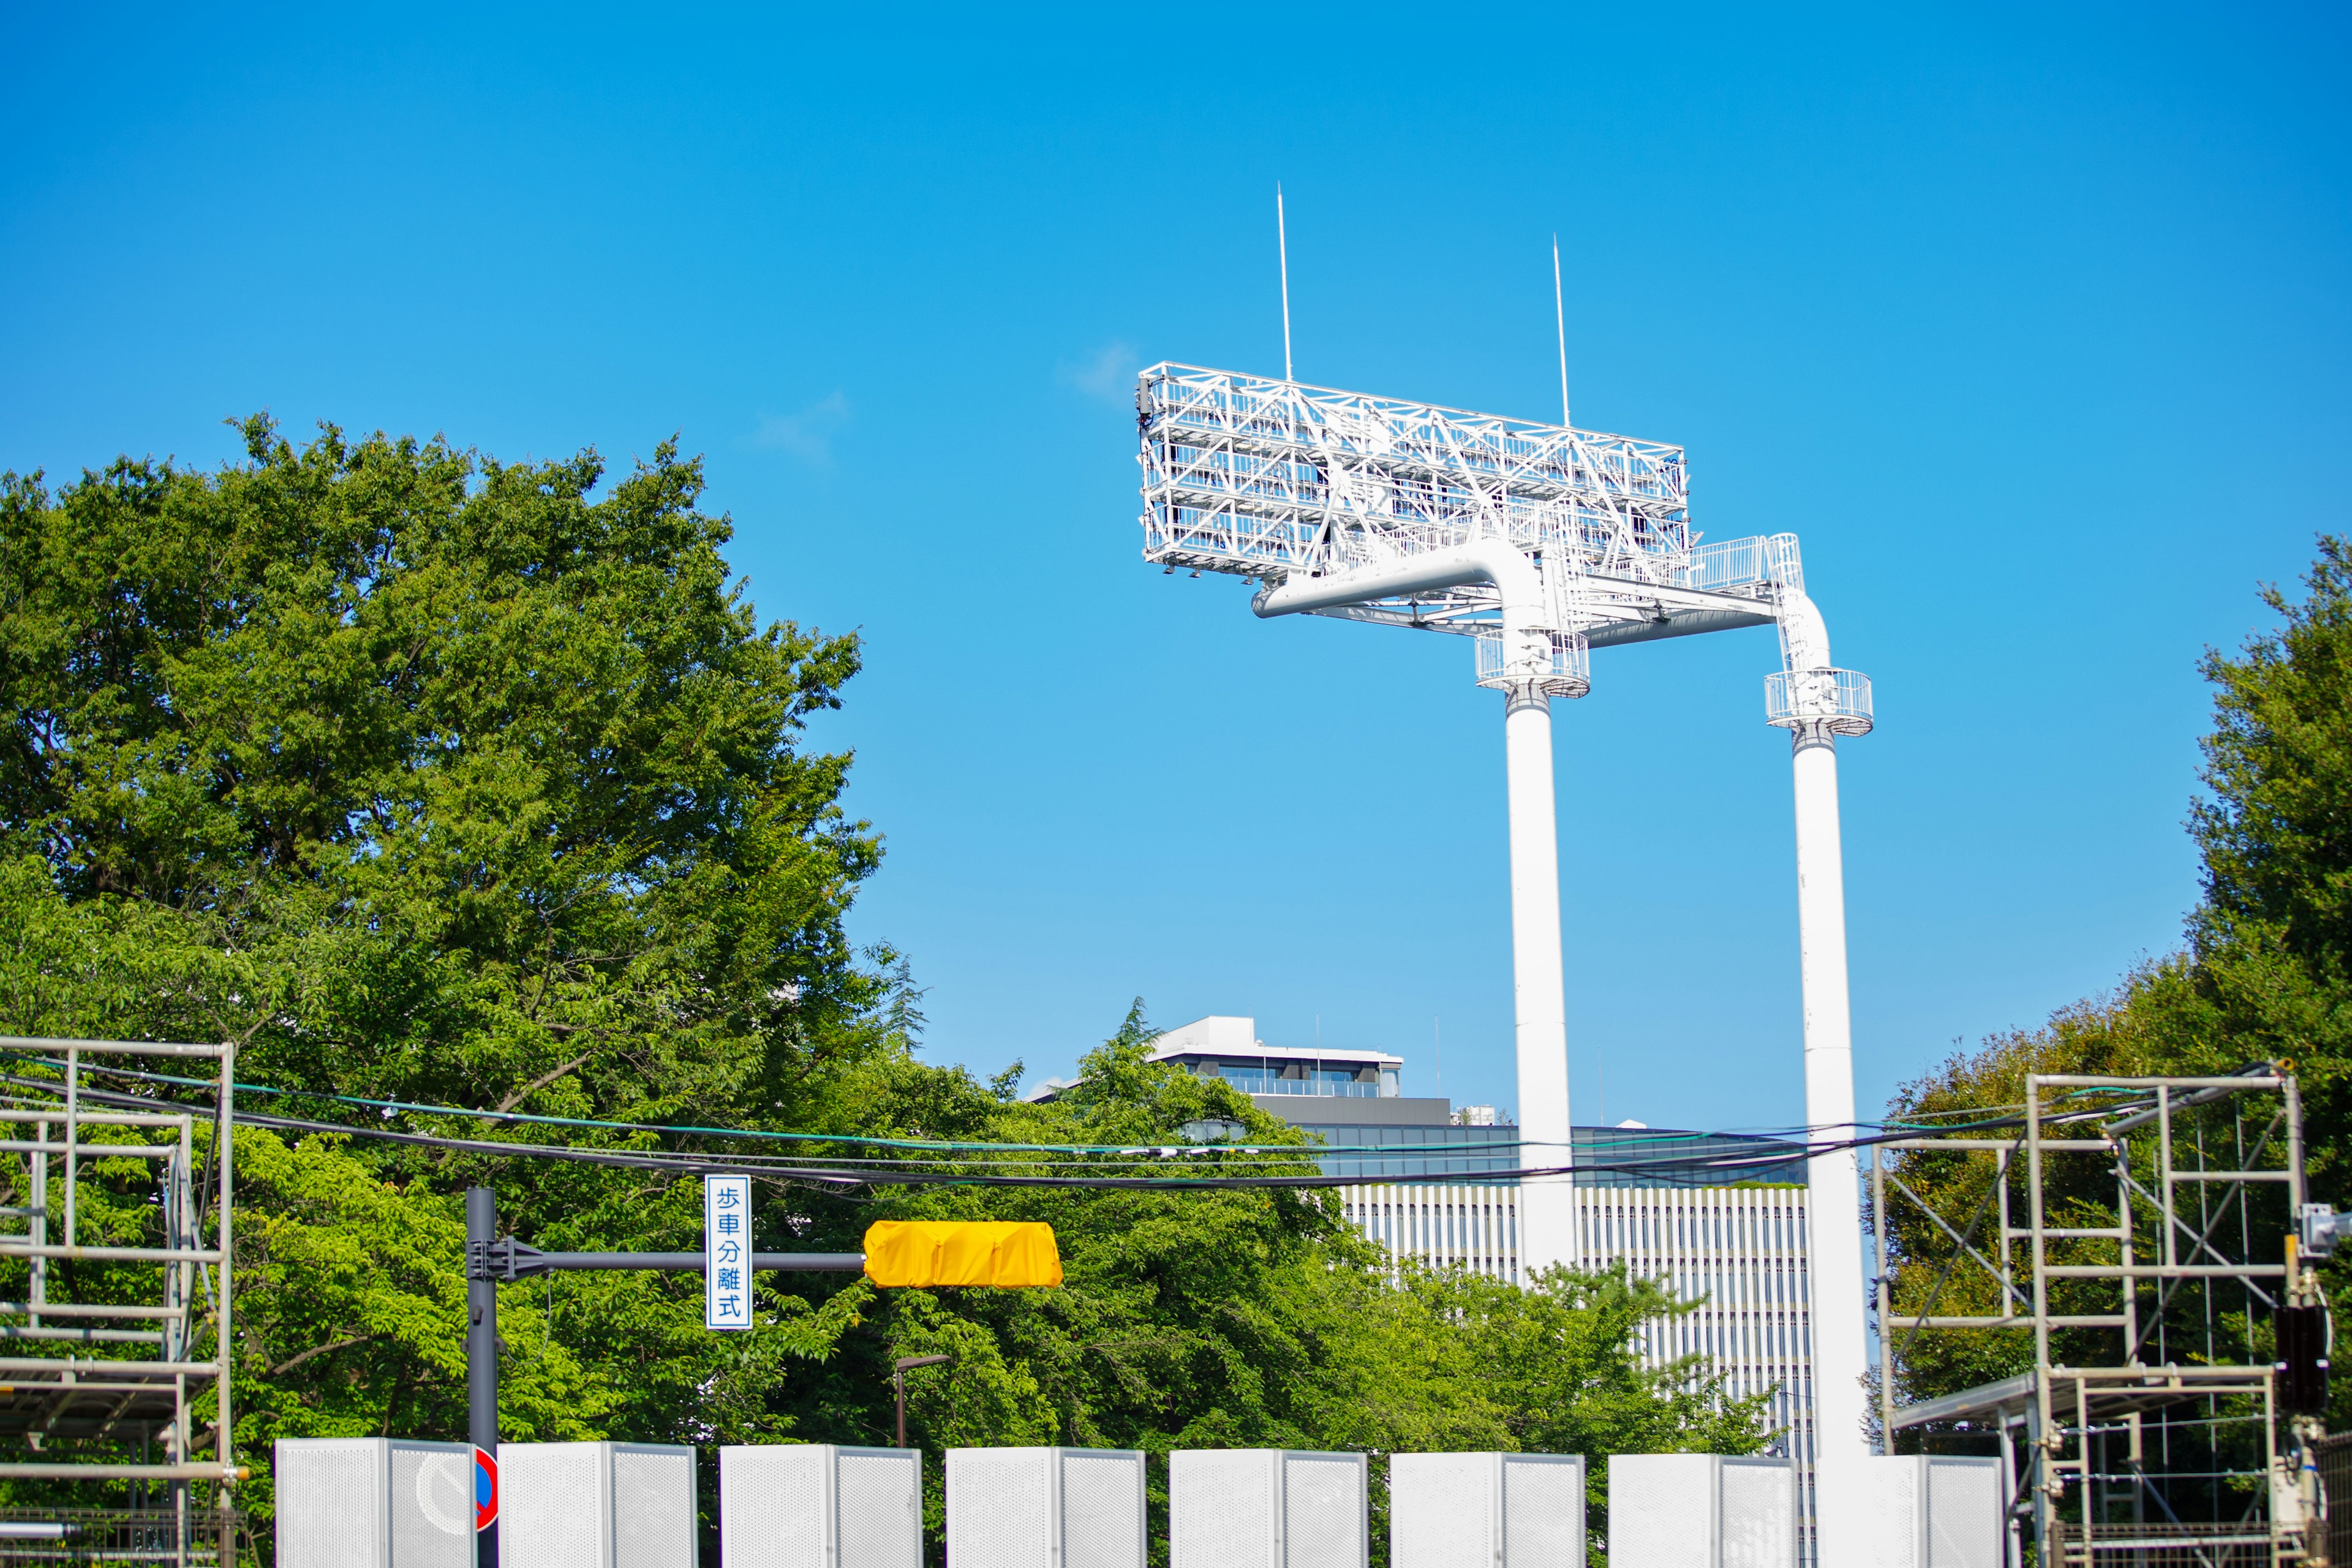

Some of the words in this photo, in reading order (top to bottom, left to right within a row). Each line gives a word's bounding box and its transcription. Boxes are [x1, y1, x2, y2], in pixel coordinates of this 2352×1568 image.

[717, 1187, 741, 1317] 歩車分離式
